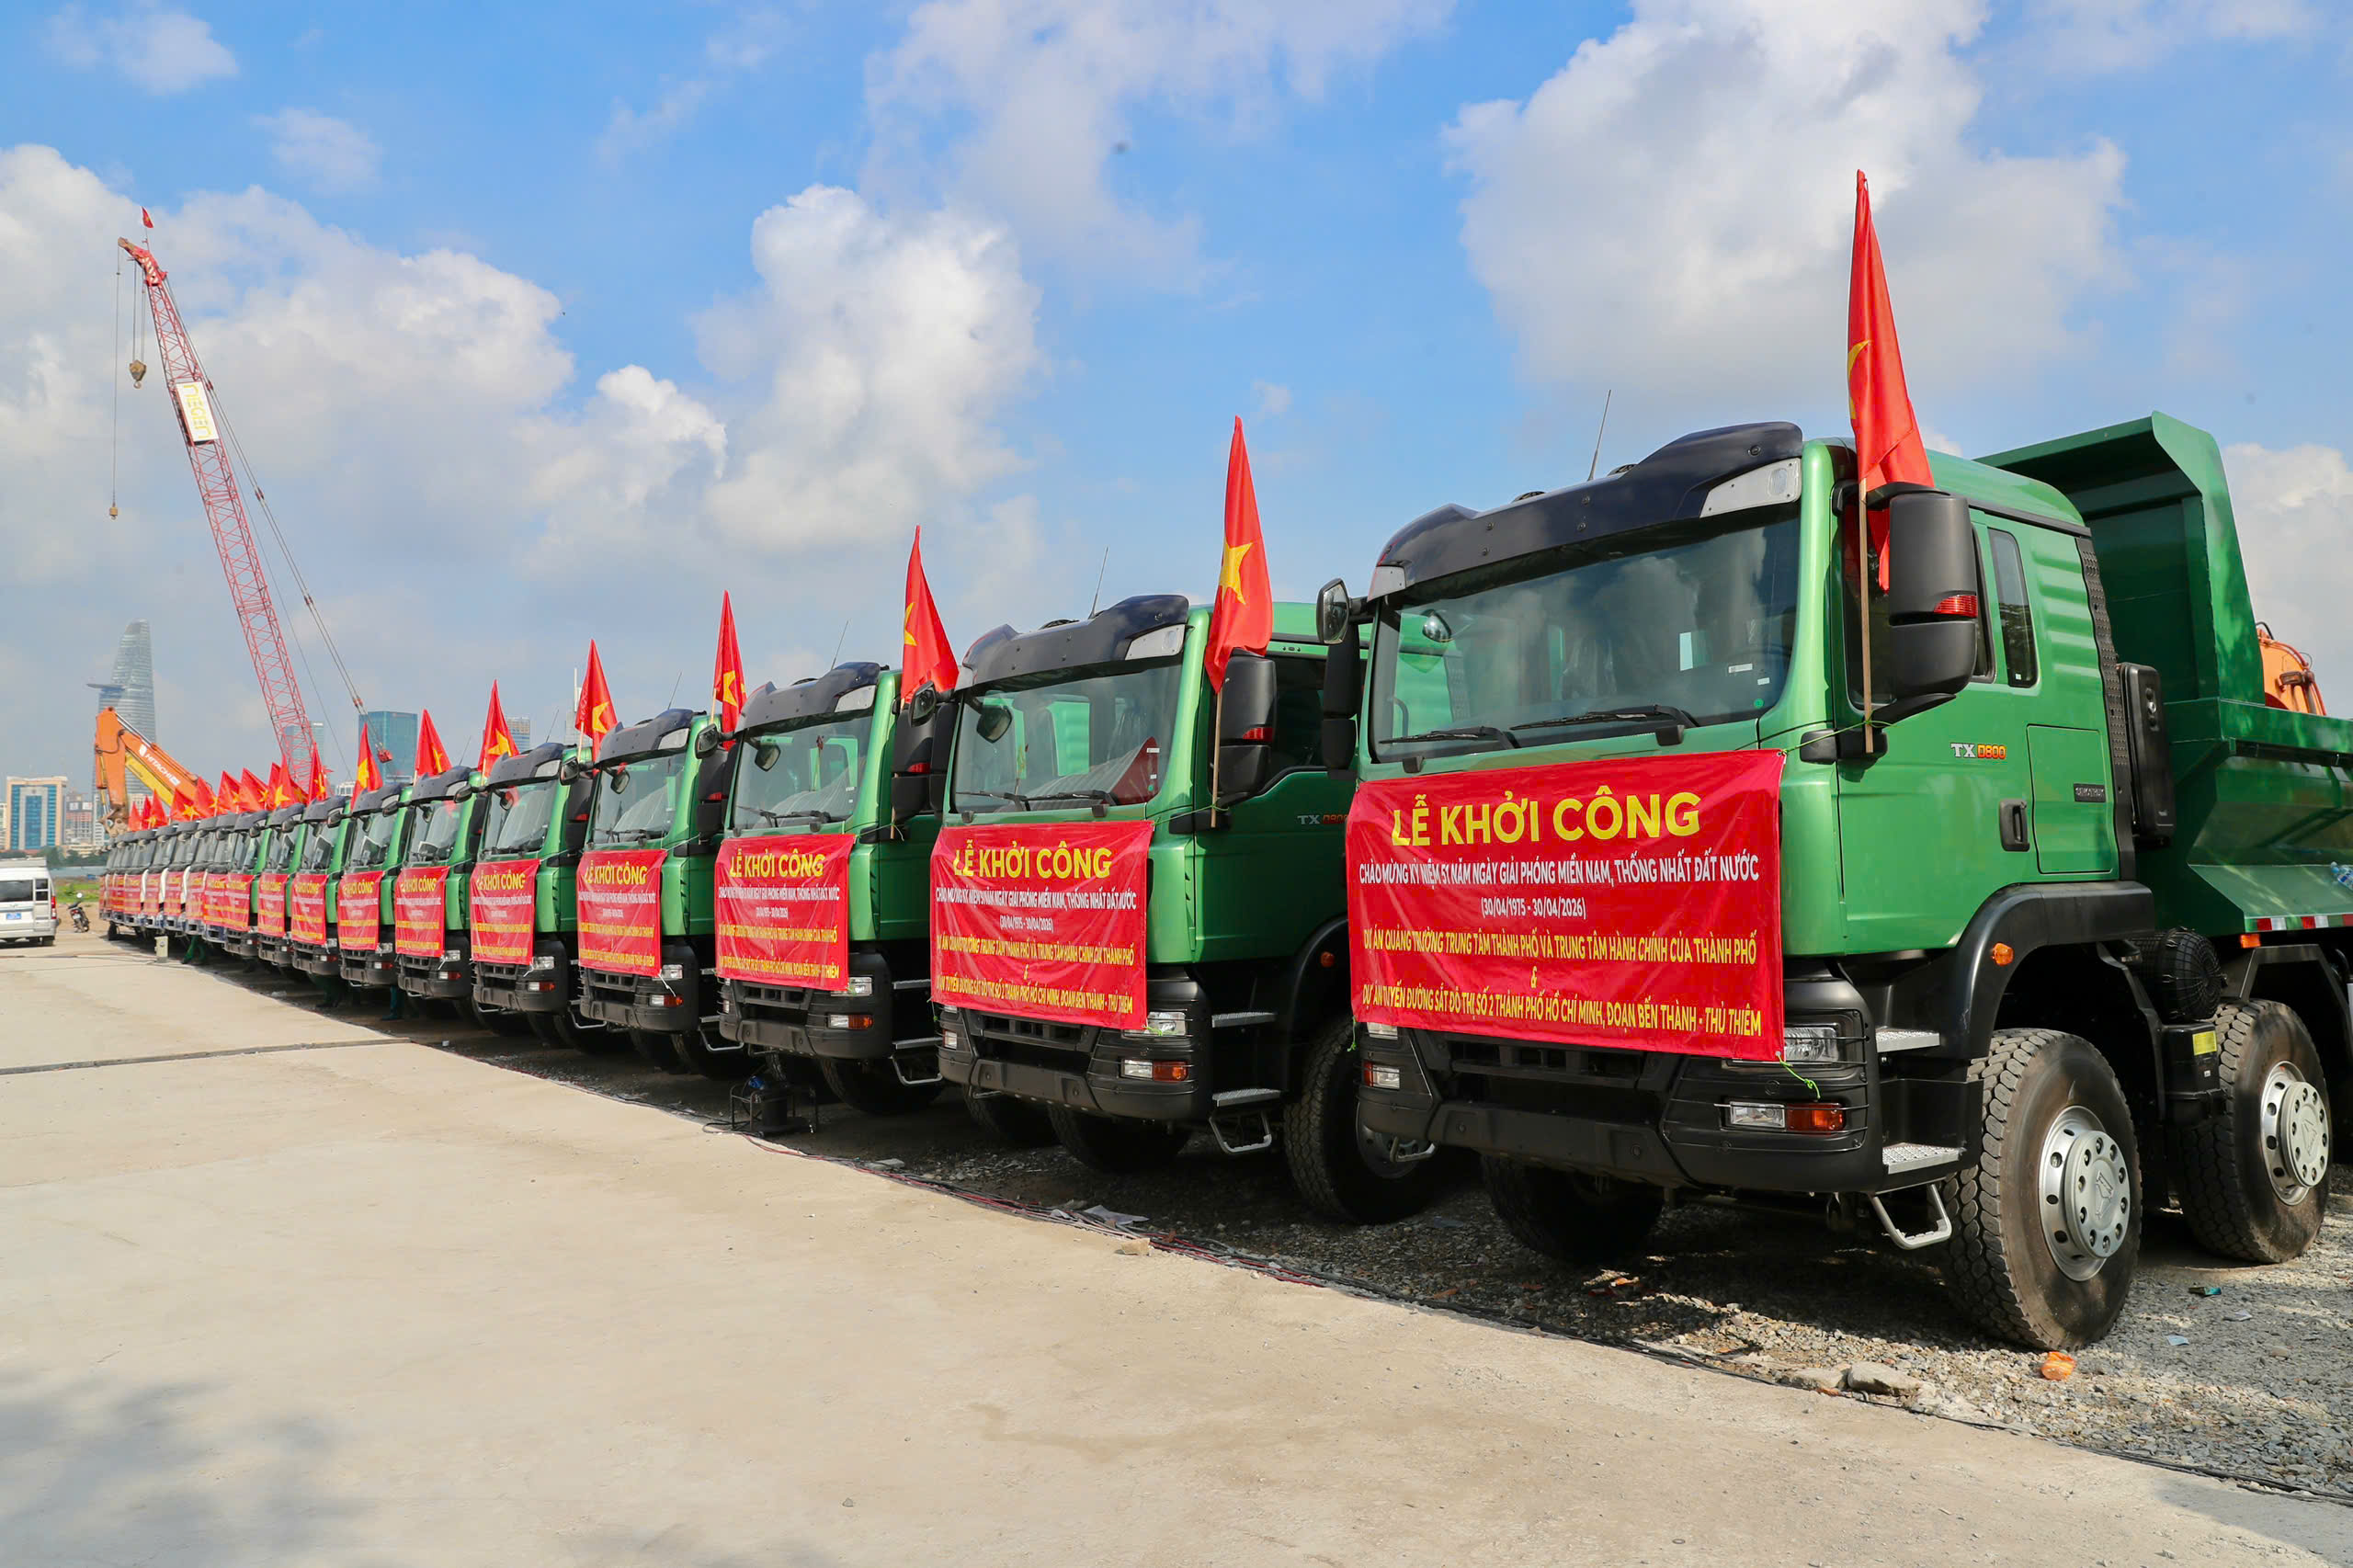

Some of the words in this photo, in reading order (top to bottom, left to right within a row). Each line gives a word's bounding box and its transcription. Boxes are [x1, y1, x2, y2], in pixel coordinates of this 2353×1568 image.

[1950, 743, 1976, 758] TX
[1297, 814, 1320, 824] TX
[1392, 794, 1430, 846] LỄ
[1440, 790, 1540, 846] KHỞI
[1552, 785, 1700, 841] CÔNG
[617, 861, 648, 885] CÔNG
[745, 848, 775, 878] KHỞI
[779, 848, 825, 878] CÔNG
[952, 839, 974, 877] LỄ
[979, 840, 1030, 878] KHỞI
[1036, 840, 1112, 879] CÔNG
[1359, 858, 1381, 884] CHÀO
[1382, 858, 1408, 884] MỪNG
[1451, 858, 1472, 884] NĂM
[1473, 857, 1498, 884] NGÀY
[1499, 856, 1518, 884] GIẢI
[1521, 856, 1555, 884] PHÓNG
[1558, 852, 1584, 884] MIỀN
[1586, 859, 1614, 887] NAM,
[1614, 850, 1656, 882] THỐNG
[1660, 848, 1691, 882] NHẤT
[1694, 847, 1717, 881] ĐẤT
[1720, 847, 1759, 881] NƯỚC
[1481, 896, 1526, 918] (30/04/1975
[1532, 896, 1586, 920] 30/04/2026)
[1373, 924, 1384, 949] ÁN
[1385, 924, 1412, 951] QUẢNG
[1412, 926, 1443, 953] TRƯỜNG
[1445, 932, 1472, 954] TRUNG
[1473, 927, 1491, 955] TÂM
[1491, 927, 1519, 956] THÀNH
[1520, 926, 1539, 957] PHỐ
[1540, 928, 1553, 958] VÀ
[1554, 935, 1586, 959] TRUNG
[1587, 929, 1608, 960] TÂM
[1609, 930, 1636, 961] HÀNH
[1638, 930, 1667, 961] CHÍNH
[1670, 930, 1693, 962] CỦA
[1693, 931, 1732, 963] THÀNH
[1733, 929, 1757, 964] PHỐ
[1530, 965, 1538, 989] &
[1406, 983, 1434, 1011] ĐƯỜNG
[1435, 982, 1449, 1012] SẮT
[1449, 985, 1461, 1013] ĐÔ
[1461, 992, 1476, 1020] THỊ
[1476, 985, 1490, 1016] SỐ
[1489, 994, 1495, 1016] 2
[1495, 989, 1524, 1019] THÀNH
[1525, 989, 1545, 1020] PHỐ
[1545, 990, 1560, 1021] HỒ
[1561, 994, 1577, 1023] CHÍ
[1578, 999, 1606, 1029] MINH,
[1607, 1001, 1636, 1033] ĐOẠN
[1637, 995, 1658, 1028] BẾN
[1660, 1000, 1697, 1031] THÀNH
[1705, 1001, 1726, 1034] THỦ
[1728, 1003, 1762, 1037] THIÊM
